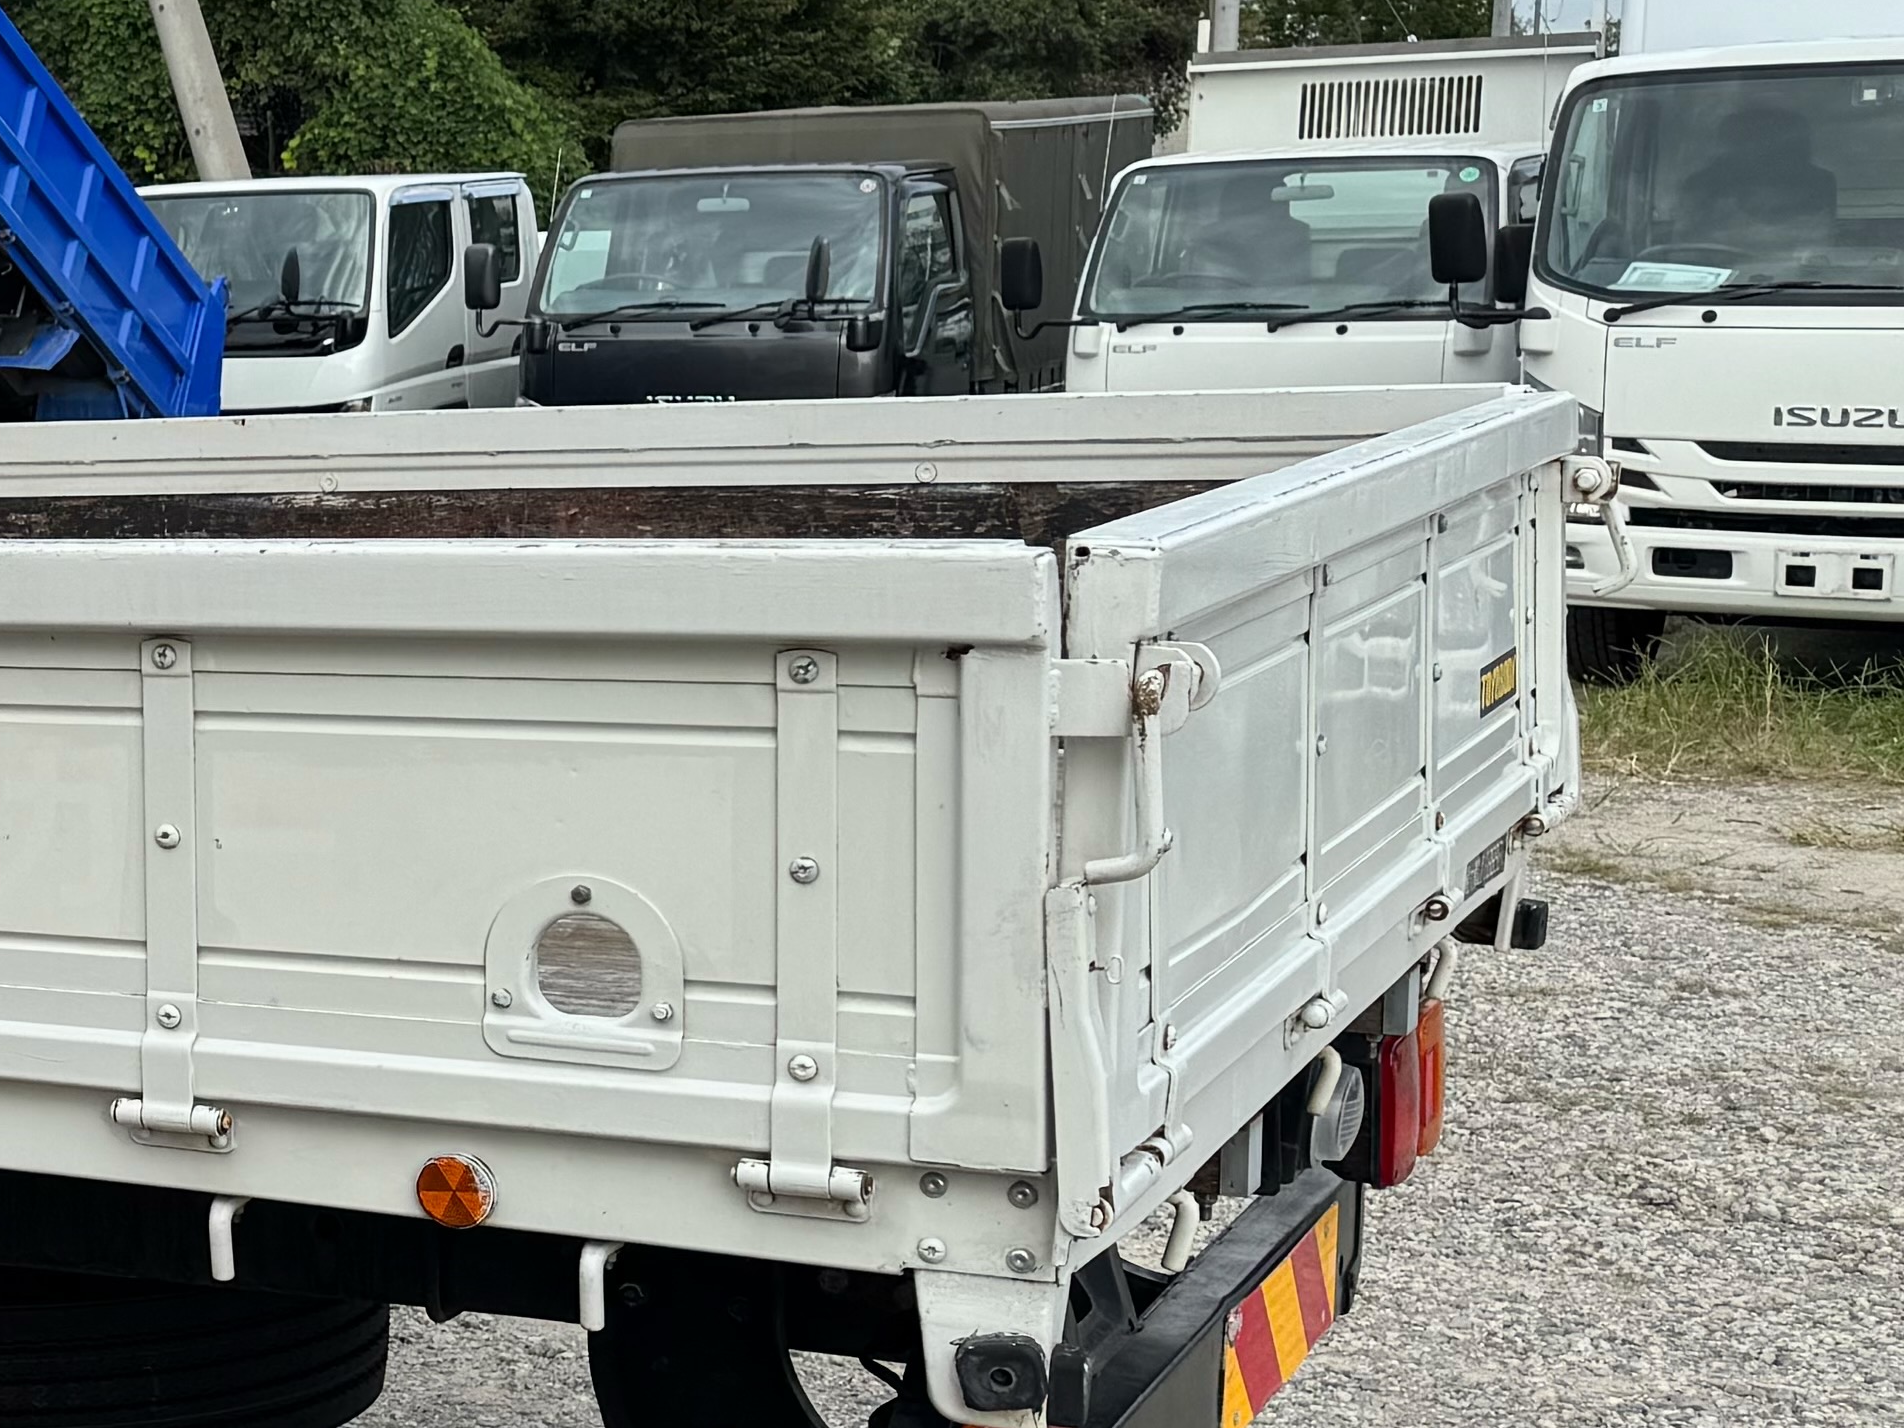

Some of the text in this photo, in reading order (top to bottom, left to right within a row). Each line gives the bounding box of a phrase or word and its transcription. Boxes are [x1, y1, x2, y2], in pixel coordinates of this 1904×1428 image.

[558, 342, 597, 352] ELF
[1613, 337, 1677, 348] ELF
[1112, 344, 1157, 354] ELF
